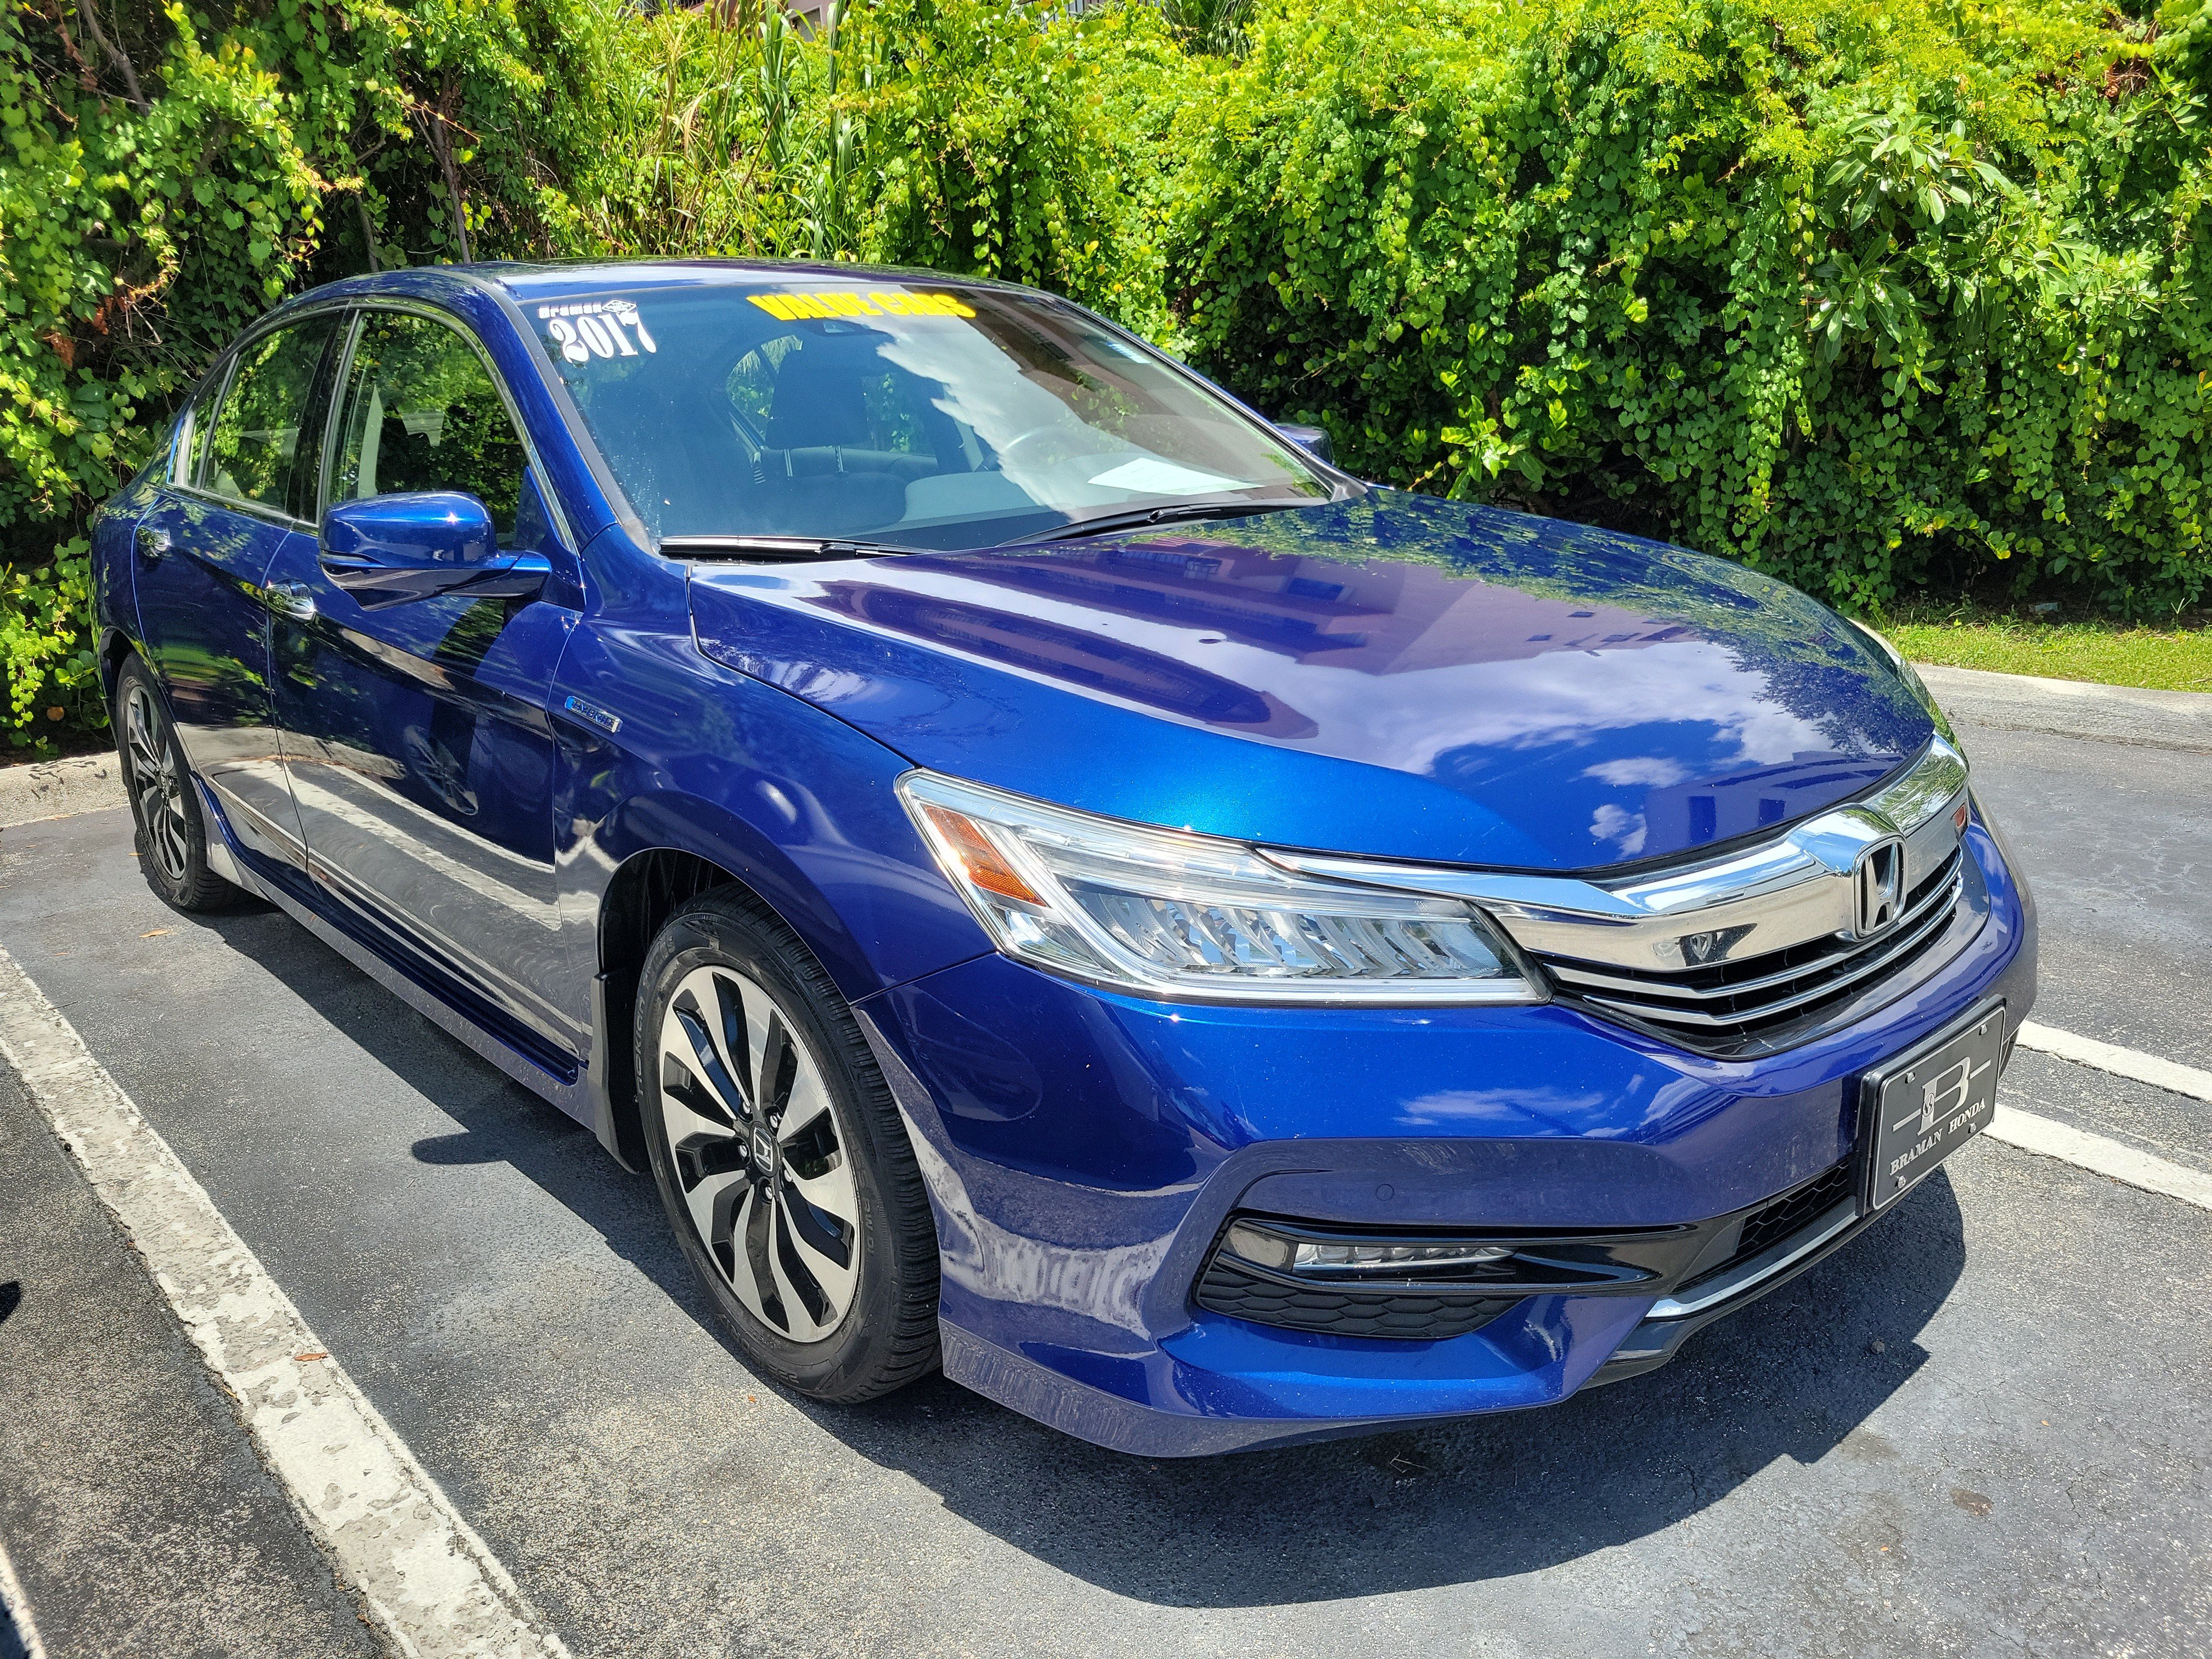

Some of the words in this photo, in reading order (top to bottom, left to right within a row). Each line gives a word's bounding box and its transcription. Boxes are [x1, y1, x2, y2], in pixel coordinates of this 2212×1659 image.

[746, 293, 883, 320] VALUE
[867, 292, 976, 318] CARS
[549, 312, 657, 363] 2017
[1889, 1128, 1943, 1176] BRAMAN
[1948, 1098, 1985, 1135] HONDA
